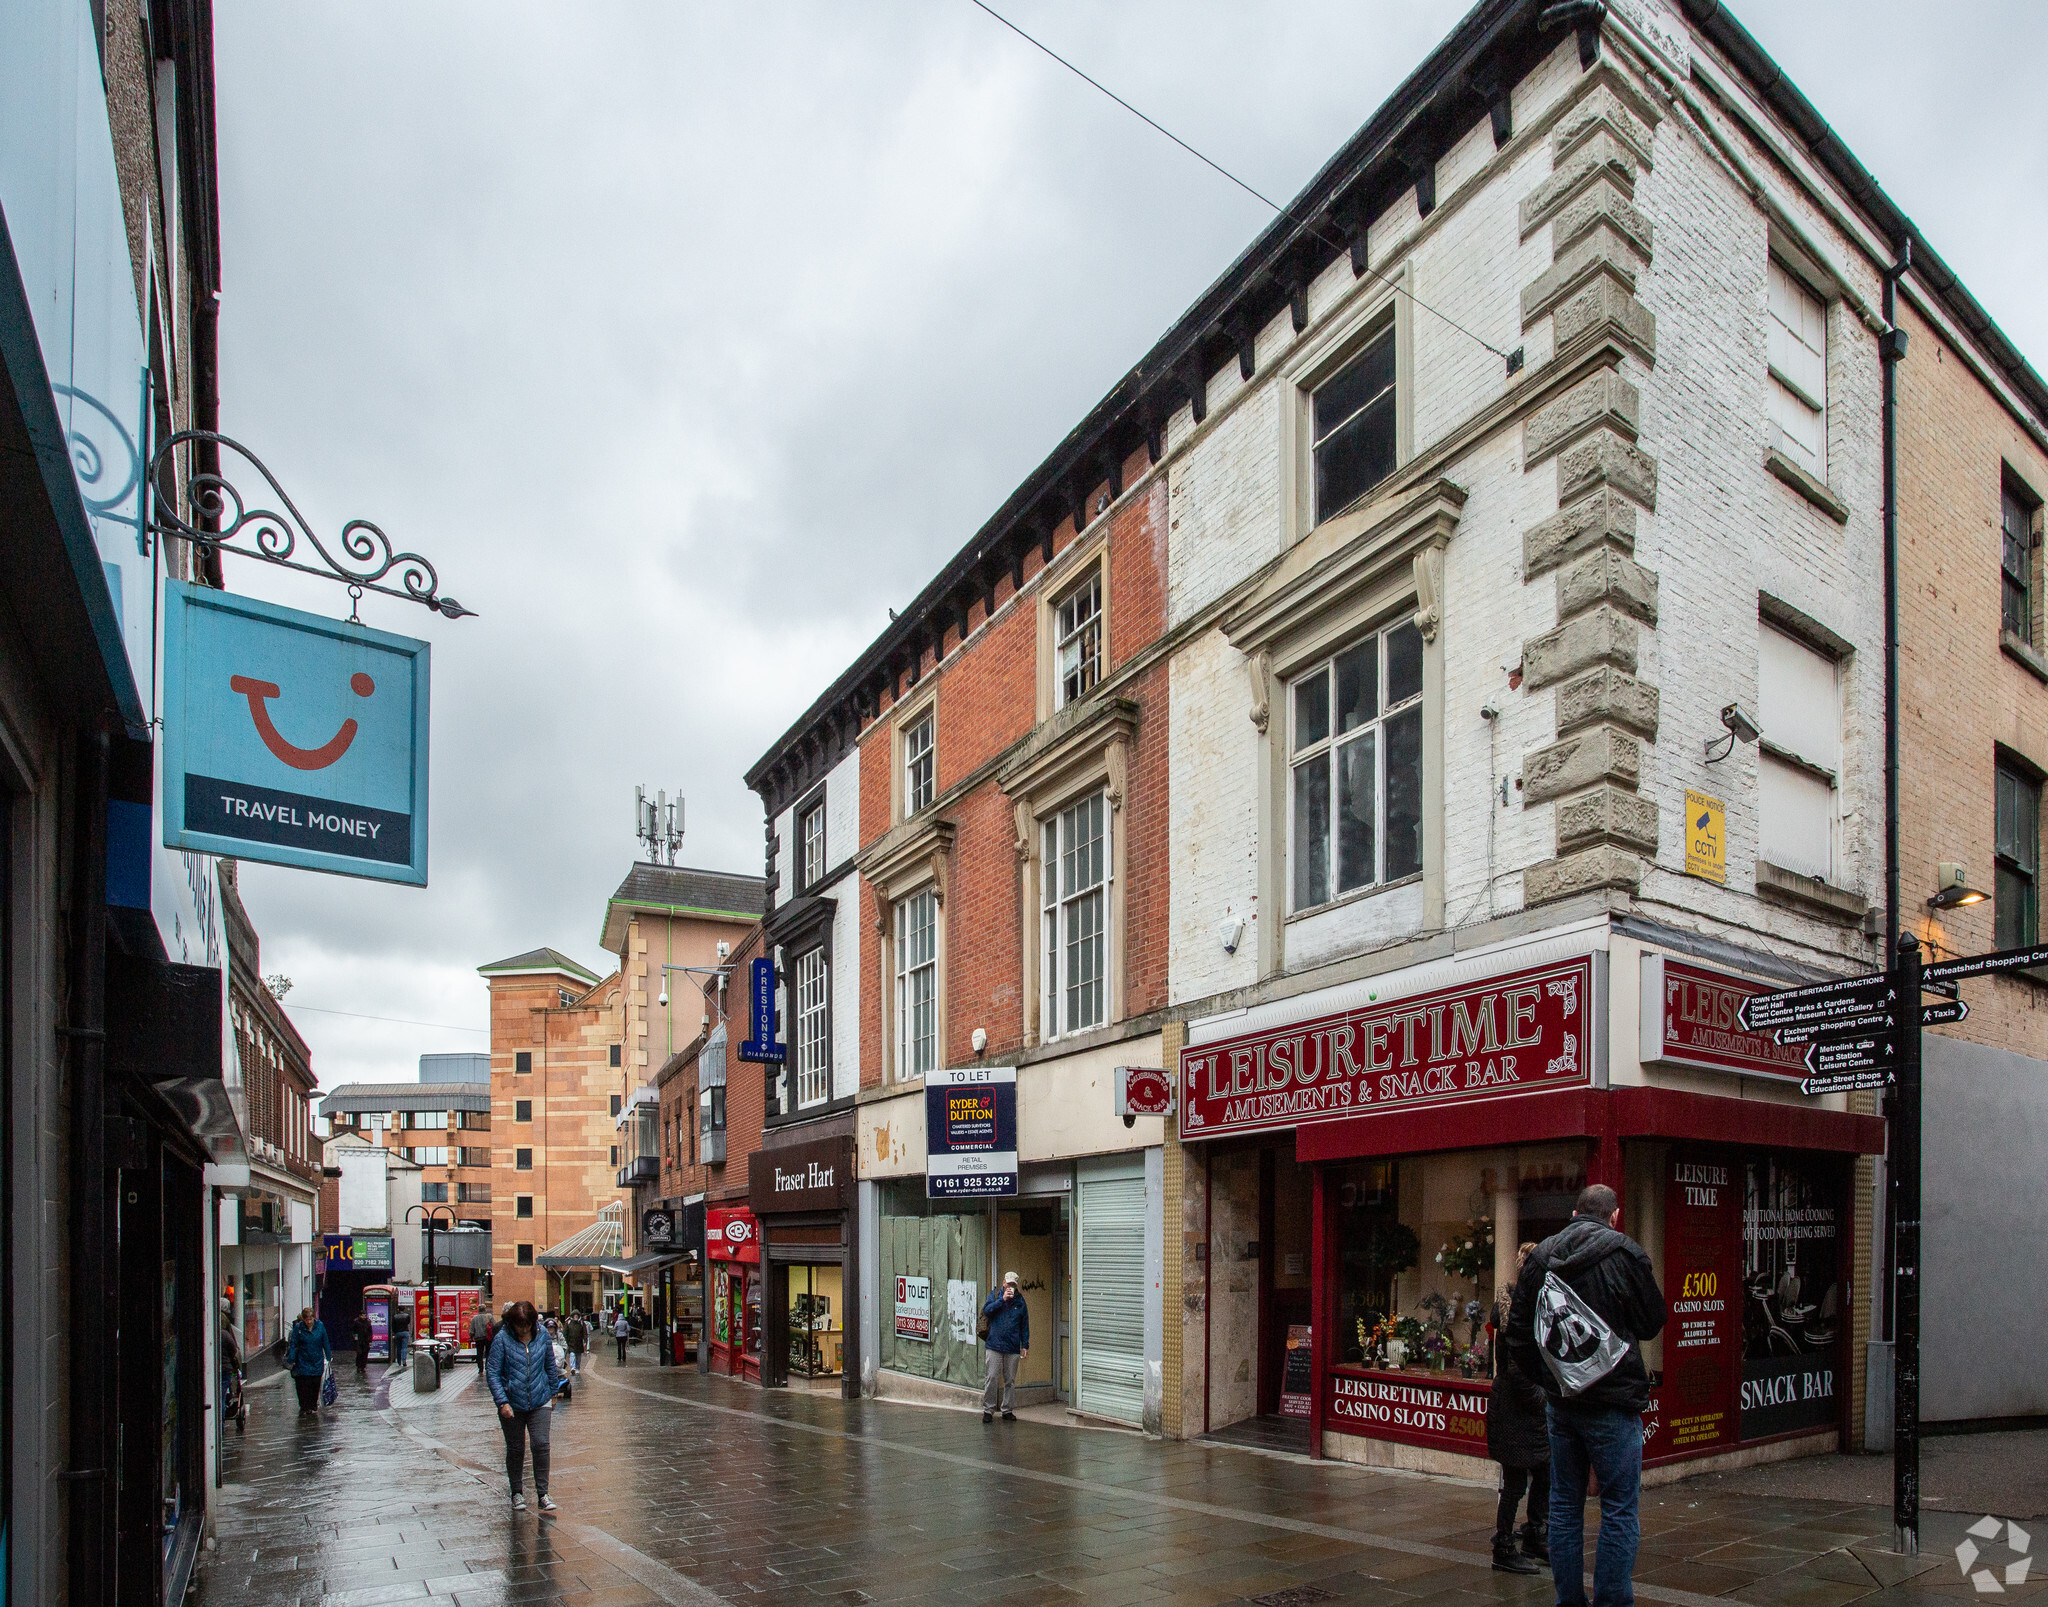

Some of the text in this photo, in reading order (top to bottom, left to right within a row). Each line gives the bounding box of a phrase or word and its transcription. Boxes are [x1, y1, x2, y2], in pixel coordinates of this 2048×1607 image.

[1686, 792, 1725, 814] POLICE NOTICE
[221, 796, 381, 839] TRAVEL MONEY
[1695, 839, 1717, 859] CCTV
[1933, 961, 1985, 976] Wheatsheaf
[1985, 955, 2030, 968] Shopping
[1751, 975, 1885, 1005] TOWN CENTRE HERITAGE ATTRACTIONS
[1751, 1001, 1784, 1012] Town Hall
[1751, 1012, 1769, 1020] Town
[1770, 1008, 1794, 1017] Centre
[1794, 1004, 1815, 1013] Parks
[1823, 997, 1856, 1008] Gardens
[1933, 1009, 1956, 1018] Taxis
[1751, 1015, 1794, 1028] Touchstones
[1795, 1011, 1826, 1021] Museum
[1827, 1008, 1834, 1016] &
[1848, 1003, 1874, 1013] Gallery
[1783, 1015, 1884, 1036] Exchange Shopping Centre
[1206, 985, 1542, 1101] LEISURETIME
[1691, 1027, 1761, 1056] AMUSEMENTS
[1763, 1041, 1770, 1059] &
[1772, 1042, 1802, 1063] SNACK
[1783, 1034, 1808, 1044] Market
[747, 1051, 783, 1059] DIAMONDS
[1819, 1043, 1854, 1053] Metrolink
[1835, 1052, 1862, 1060] Station
[1819, 1058, 1874, 1070] Leisure Centre
[949, 1071, 991, 1082] TO LET
[1128, 1072, 1168, 1091] AMUSEMENTS
[1809, 1072, 1882, 1086] Drake Street Shops
[1143, 1086, 1153, 1098] &
[1222, 1055, 1520, 1123] AMUSEMENTS & SNACK BAR
[1809, 1080, 1885, 1094] Educational Quarter
[950, 1096, 991, 1110] RYDER &
[1130, 1097, 1167, 1112] SNACK BAR
[950, 1109, 993, 1121] DUTTON
[951, 1143, 993, 1151] COMMERCIAL
[774, 1162, 835, 1192] Fraser Hart
[936, 1176, 1010, 1188] 0161 925 3232
[1674, 1163, 1728, 1186] LEISURE
[1685, 1186, 1718, 1207] TIME
[1743, 1208, 1835, 1223] RADITIONAL HOME COOKING
[1755, 1227, 1775, 1240] FOOD
[1775, 1227, 1793, 1240] NOW
[1793, 1226, 1813, 1239] BEING
[1813, 1225, 1836, 1238] SERVED
[908, 1284, 929, 1299] TO LET
[1682, 1272, 1717, 1298] £500
[1673, 1300, 1725, 1313] CASINO SLOTS
[896, 1317, 929, 1332] 0113 388 4848
[1690, 1321, 1707, 1329] UNDER
[1684, 1330, 1707, 1338] ALLOWED
[1677, 1337, 1721, 1347] AMUSEMENT AREA
[1334, 1378, 1489, 1415] LEISURETIME AMU
[1740, 1373, 1797, 1411] SNACK
[1802, 1370, 1834, 1400] BAR
[1334, 1398, 1485, 1438] CASINO SLOTS £500
[1681, 1417, 1694, 1425] CCTV
[1694, 1415, 1700, 1424] IN
[1700, 1412, 1724, 1423] OPERATION
[1641, 1416, 1660, 1446] PEN
[1679, 1422, 1715, 1435] REDCARE ALARM
[1672, 1430, 1720, 1446] SYSTEM IN OPERATION
